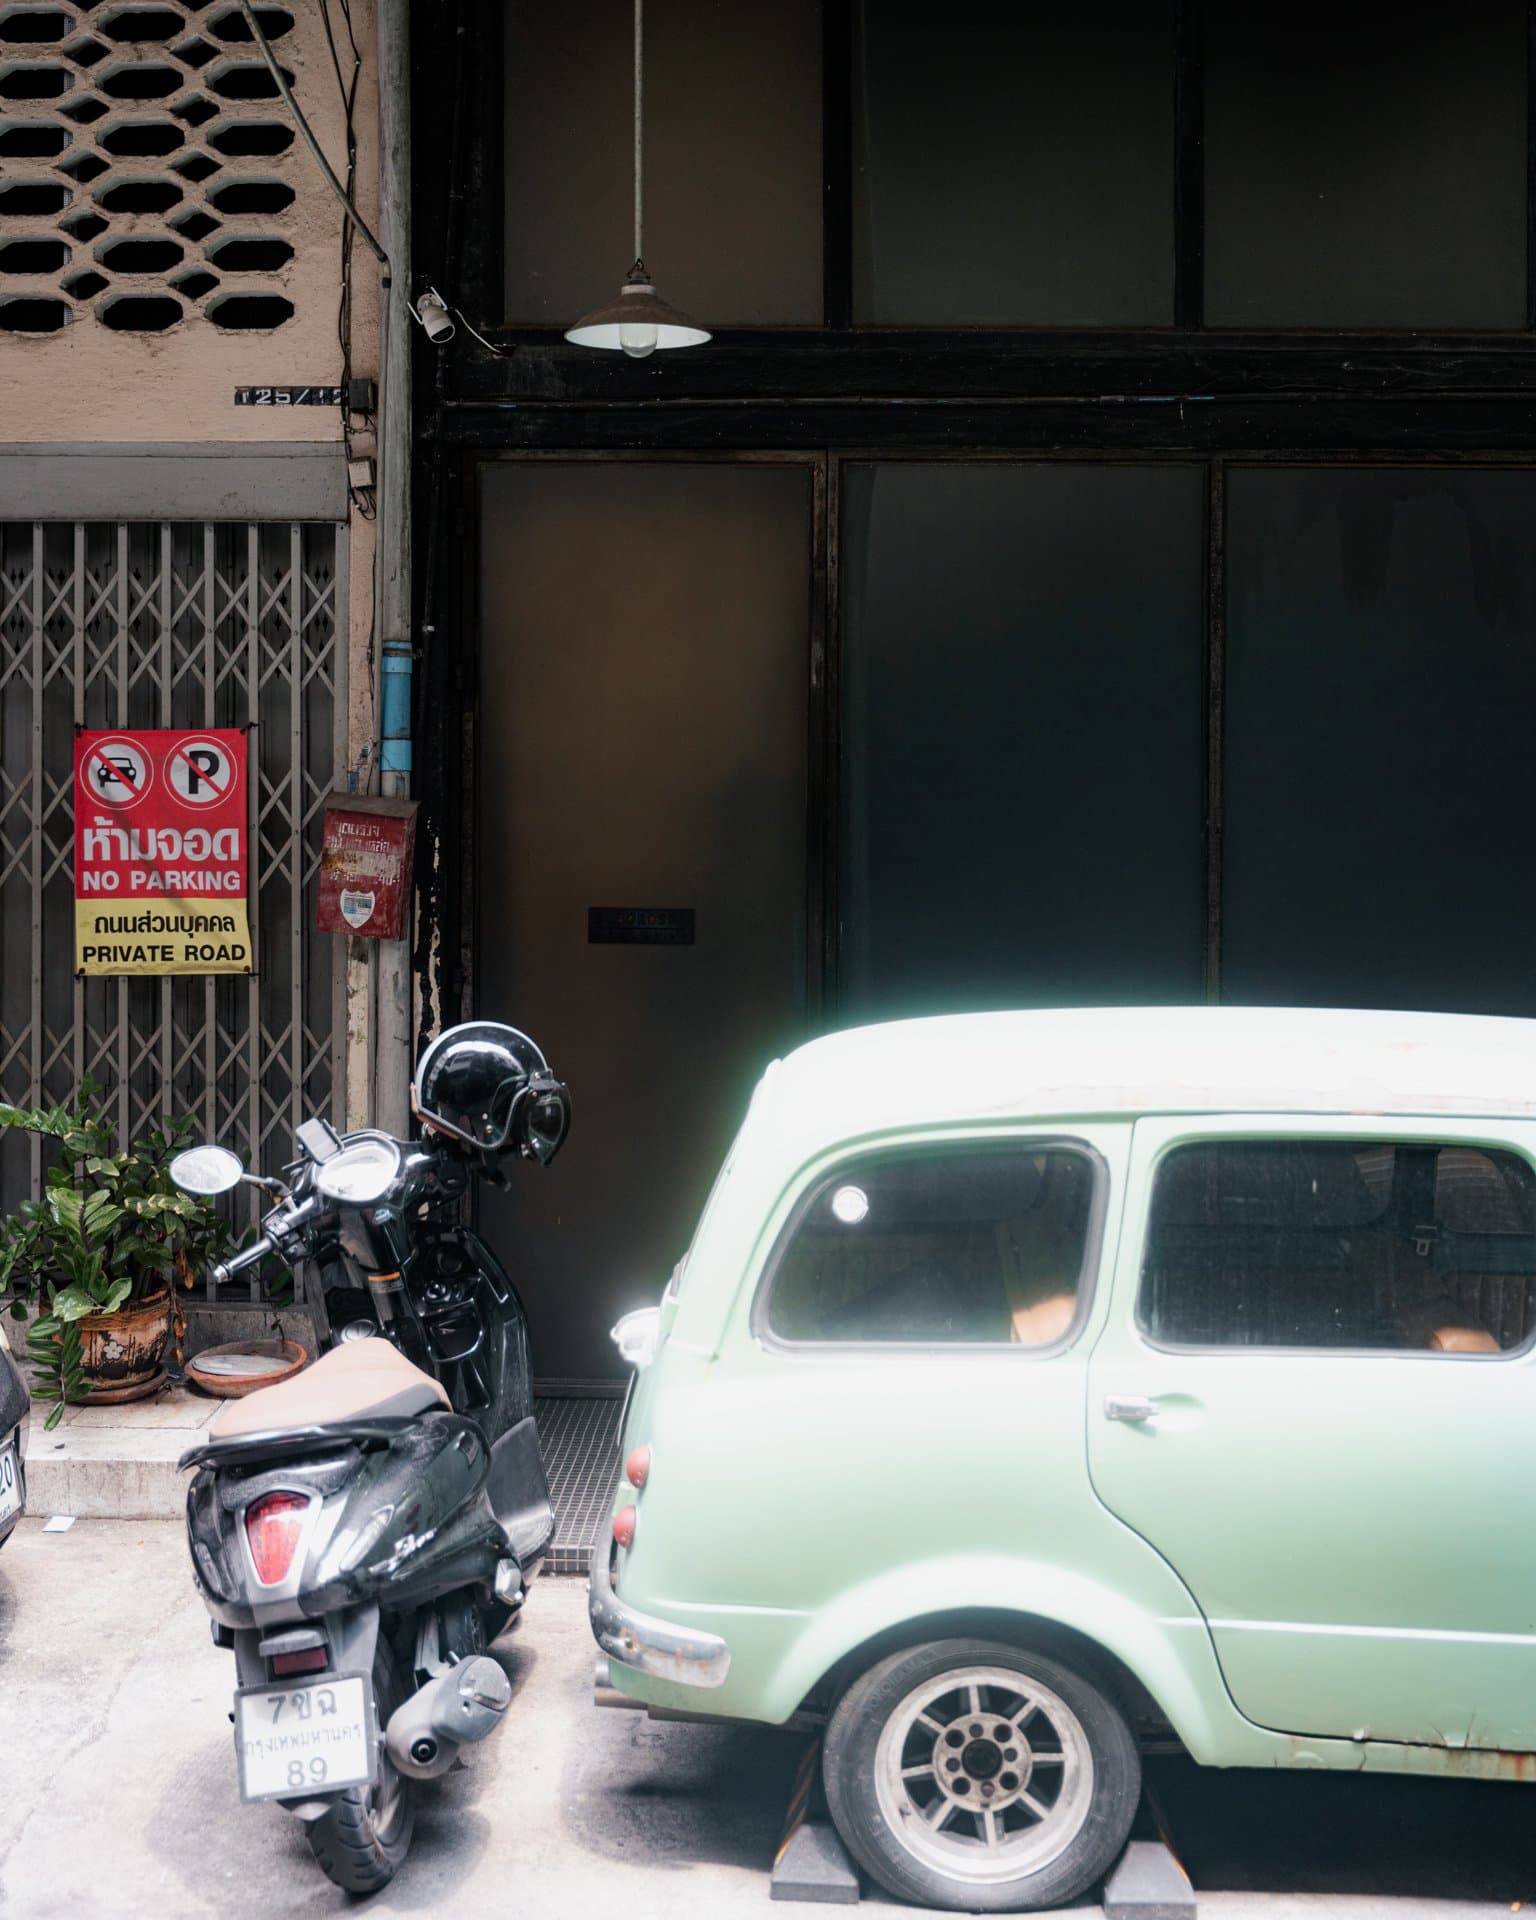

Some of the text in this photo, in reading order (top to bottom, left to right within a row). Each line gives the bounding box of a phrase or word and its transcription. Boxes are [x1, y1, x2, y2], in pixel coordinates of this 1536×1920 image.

[188, 750, 220, 794] P
[83, 816, 239, 861] ห้ามจอด
[82, 870, 241, 891] NO PARKING
[95, 911, 236, 938] ถนนส่วนบุคคล
[82, 944, 246, 963] PRIVATE ROAD
[287, 1757, 327, 1786] 89
